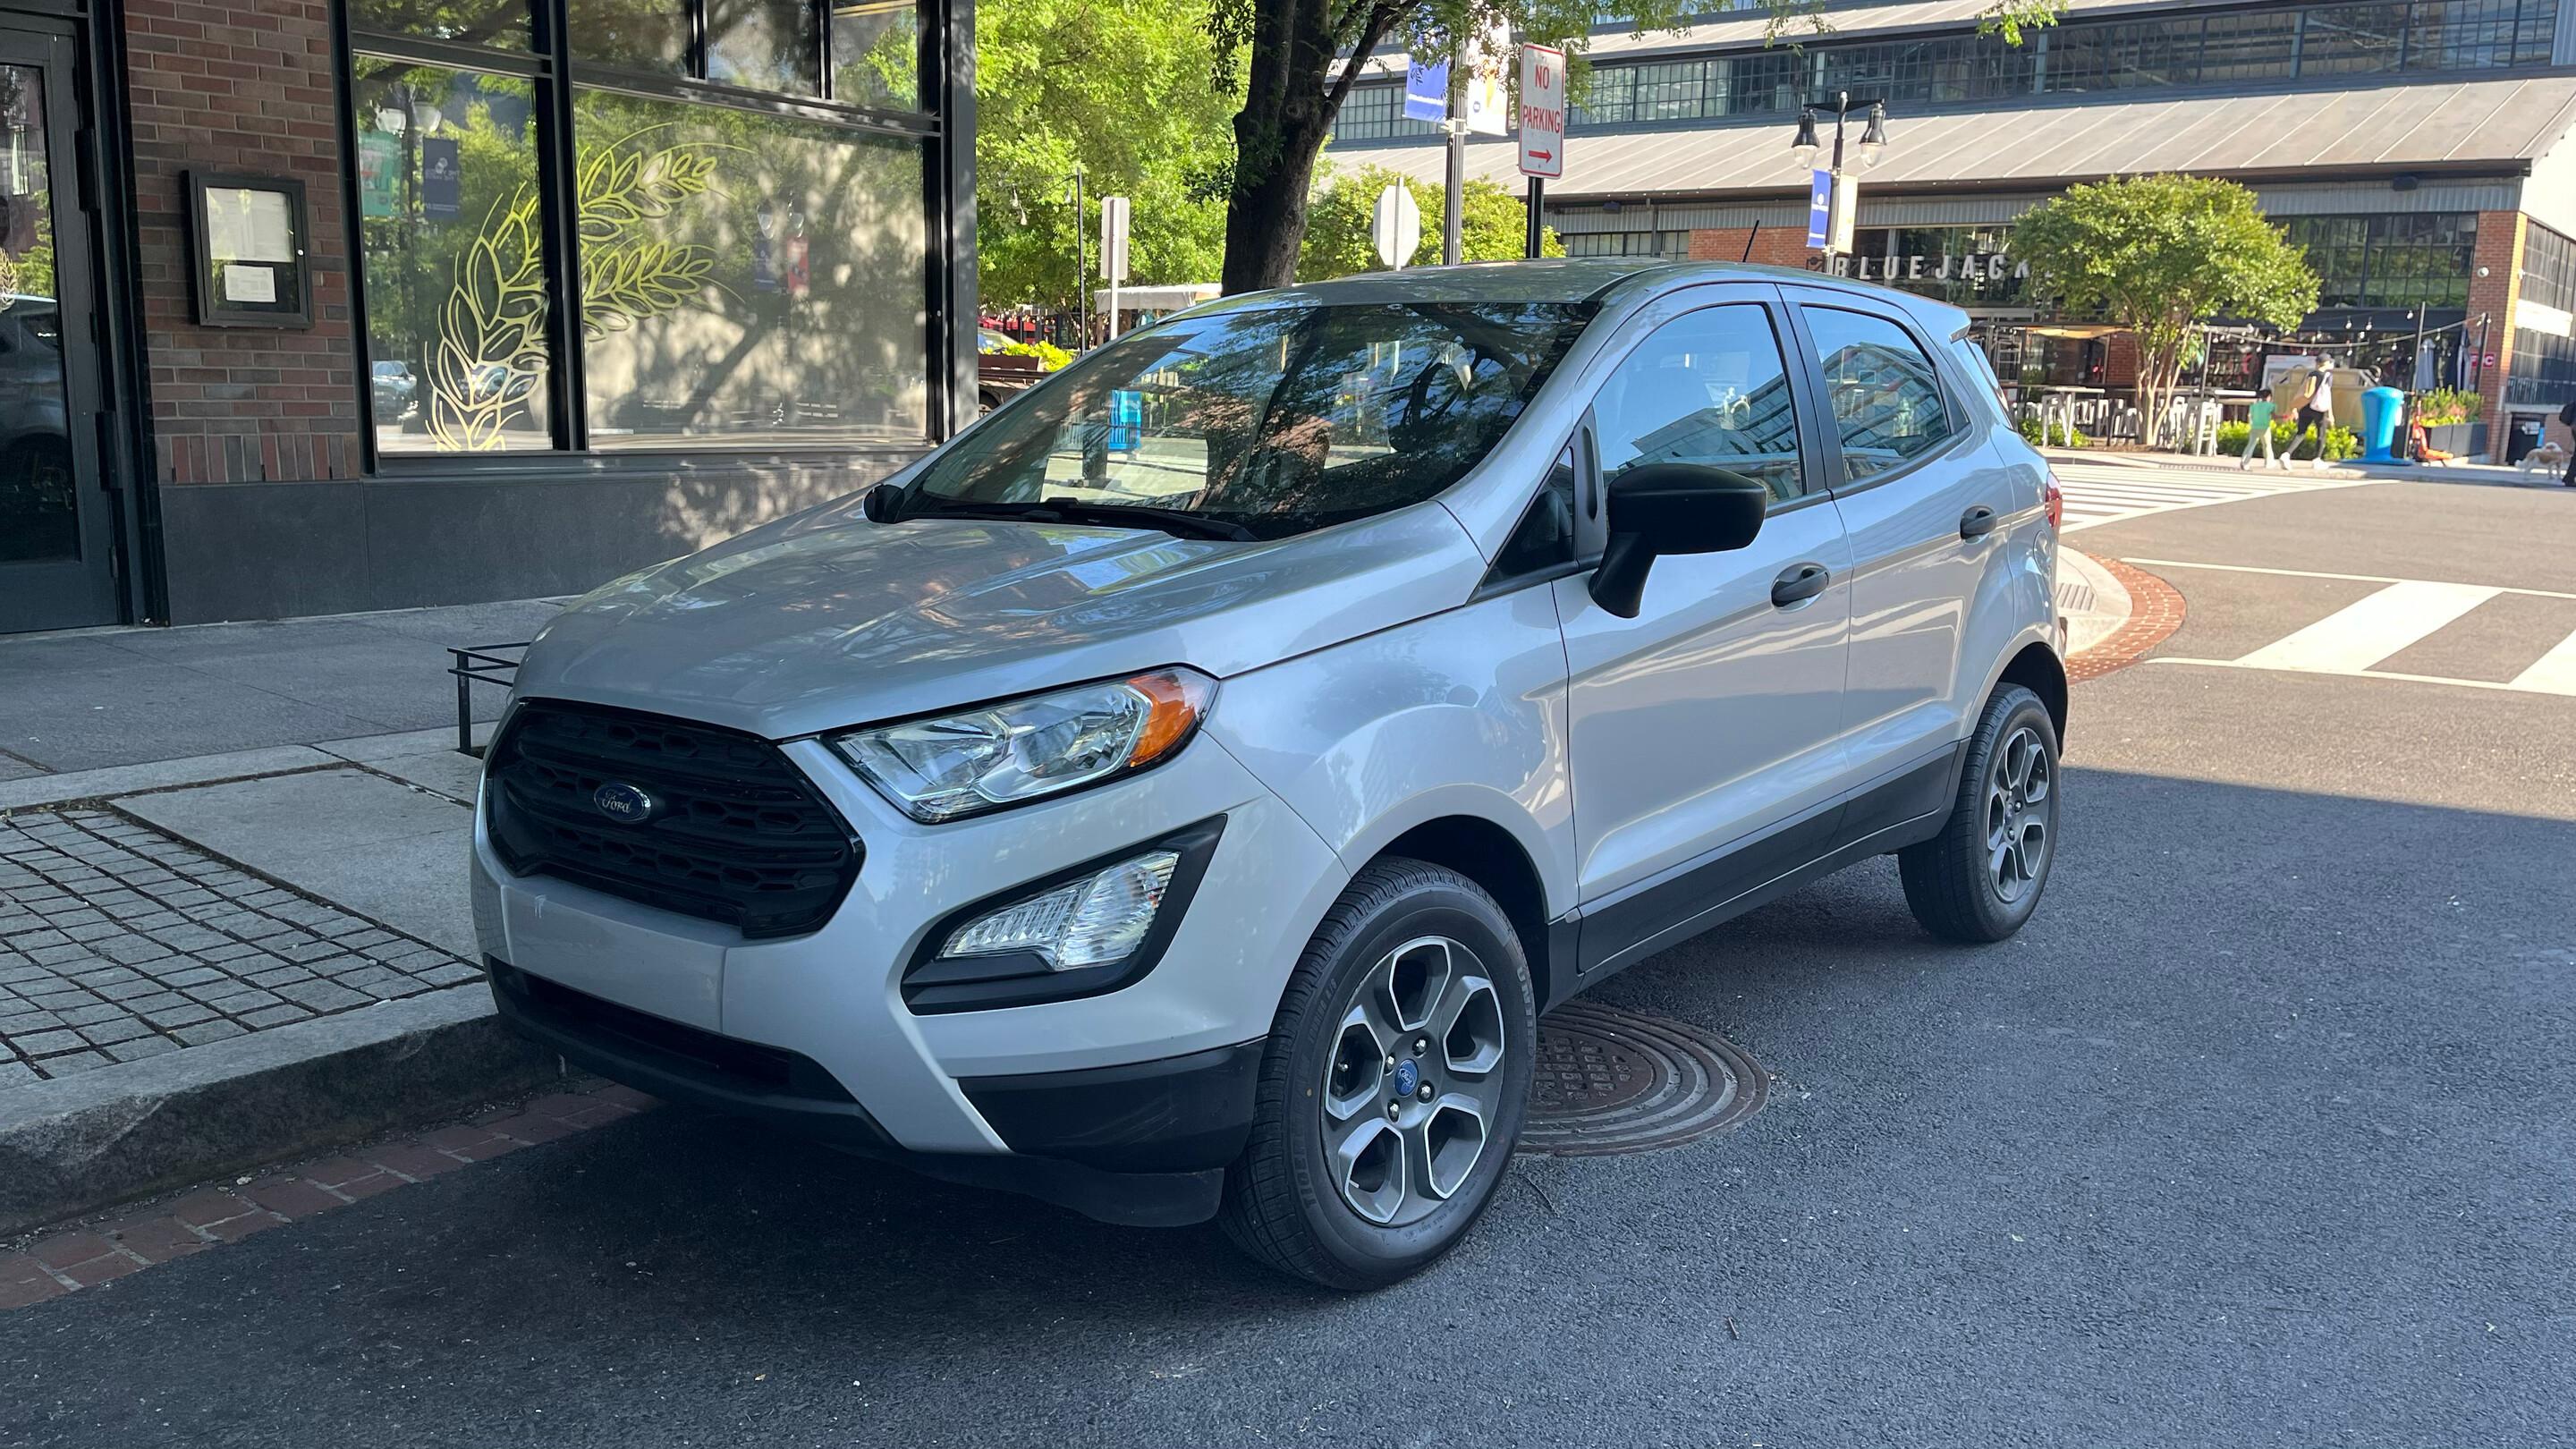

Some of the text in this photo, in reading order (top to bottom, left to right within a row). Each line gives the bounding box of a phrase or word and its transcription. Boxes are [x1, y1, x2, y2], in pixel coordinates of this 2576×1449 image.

[1535, 64, 1550, 89] NO
[1522, 105, 1561, 133] PARKING
[602, 788, 632, 814] Ford
